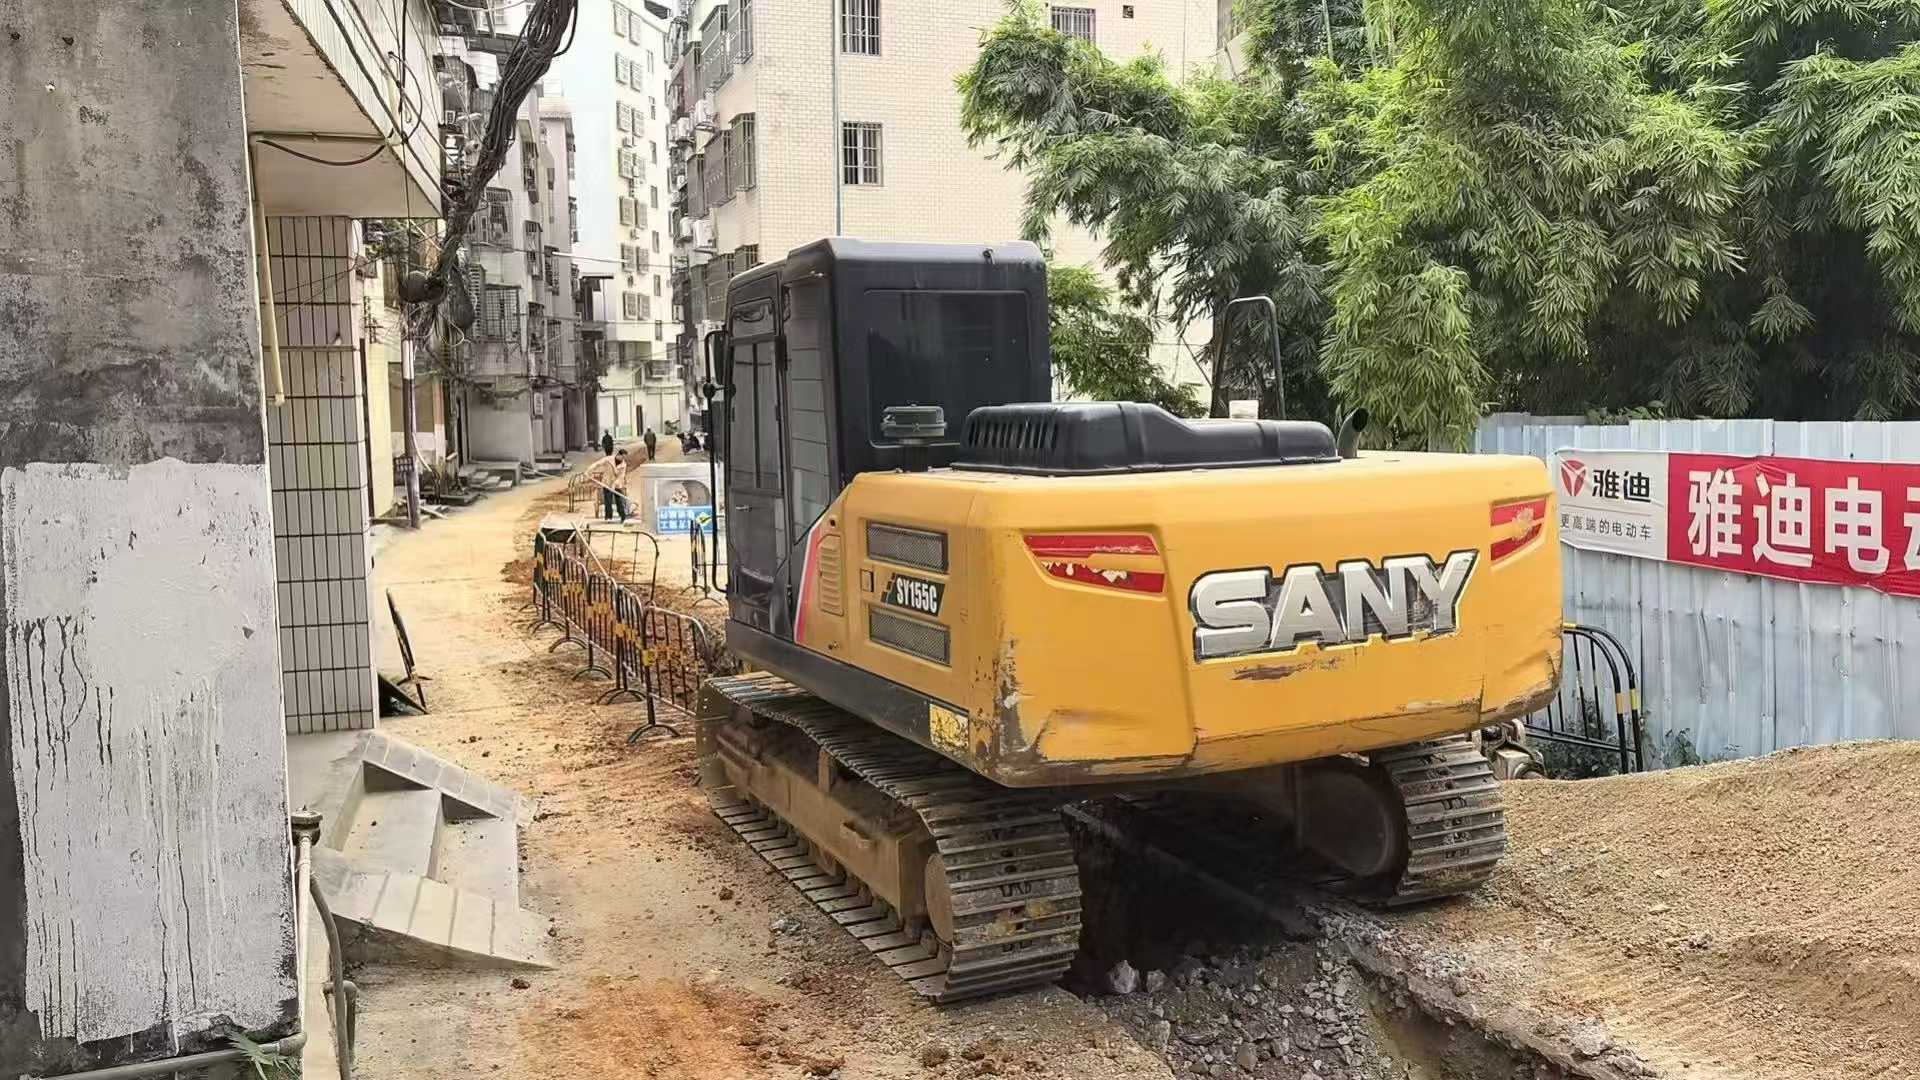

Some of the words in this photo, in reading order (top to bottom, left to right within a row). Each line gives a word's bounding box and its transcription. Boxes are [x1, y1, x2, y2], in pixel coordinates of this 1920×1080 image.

[1592, 469, 1651, 503] 雅迪
[1560, 513, 1652, 541] 更高端的电动车
[1687, 468, 1920, 575] 雅迪电
[895, 577, 938, 614] SY155C
[1190, 550, 1478, 661] SANY
